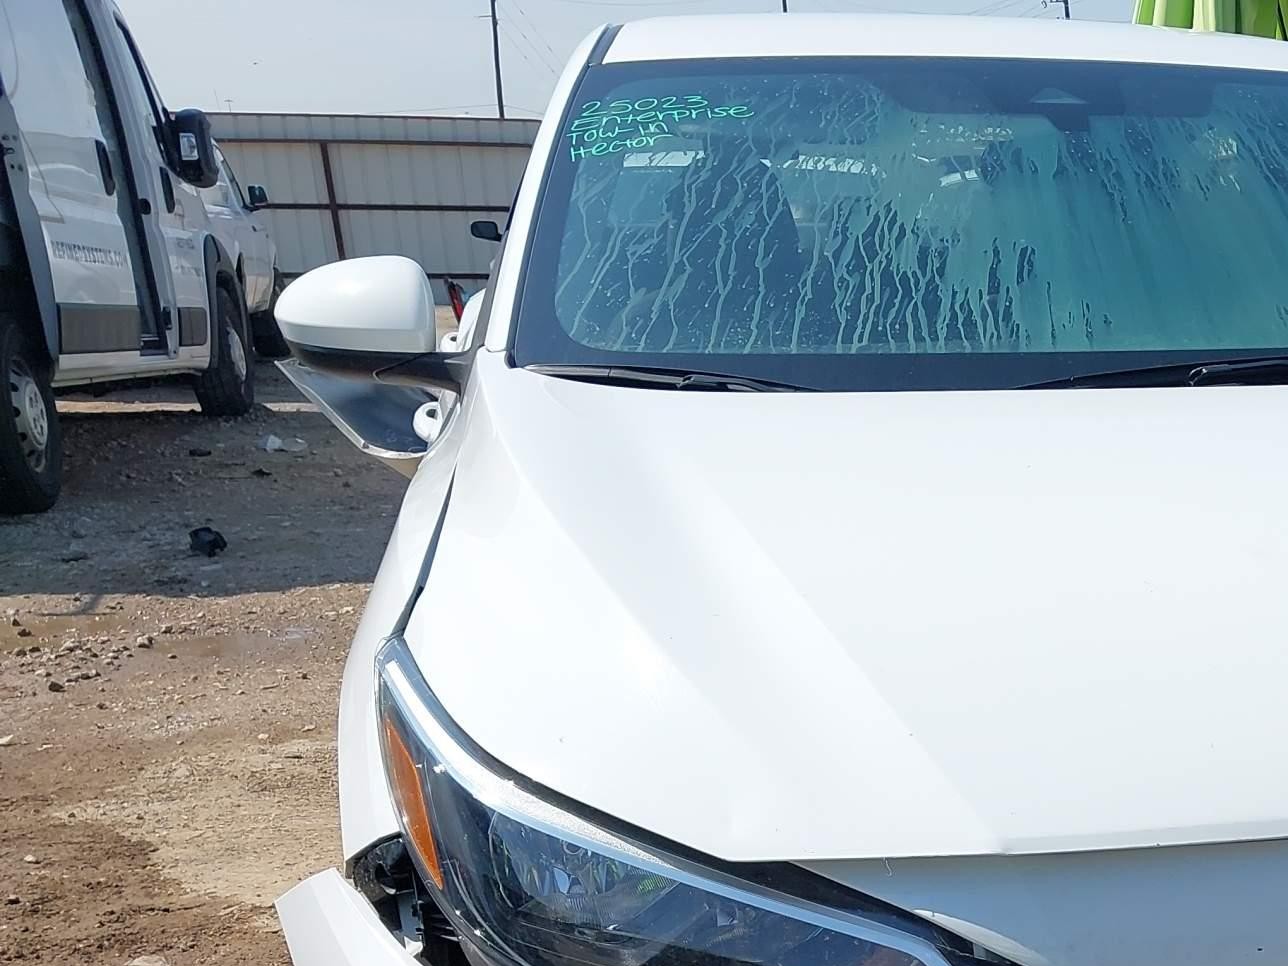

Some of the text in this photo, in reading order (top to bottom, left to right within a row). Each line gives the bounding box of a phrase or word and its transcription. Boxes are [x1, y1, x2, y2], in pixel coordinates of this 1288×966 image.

[571, 104, 755, 132] Enterprise
[582, 95, 709, 117] 25023
[570, 134, 674, 162] Hector
